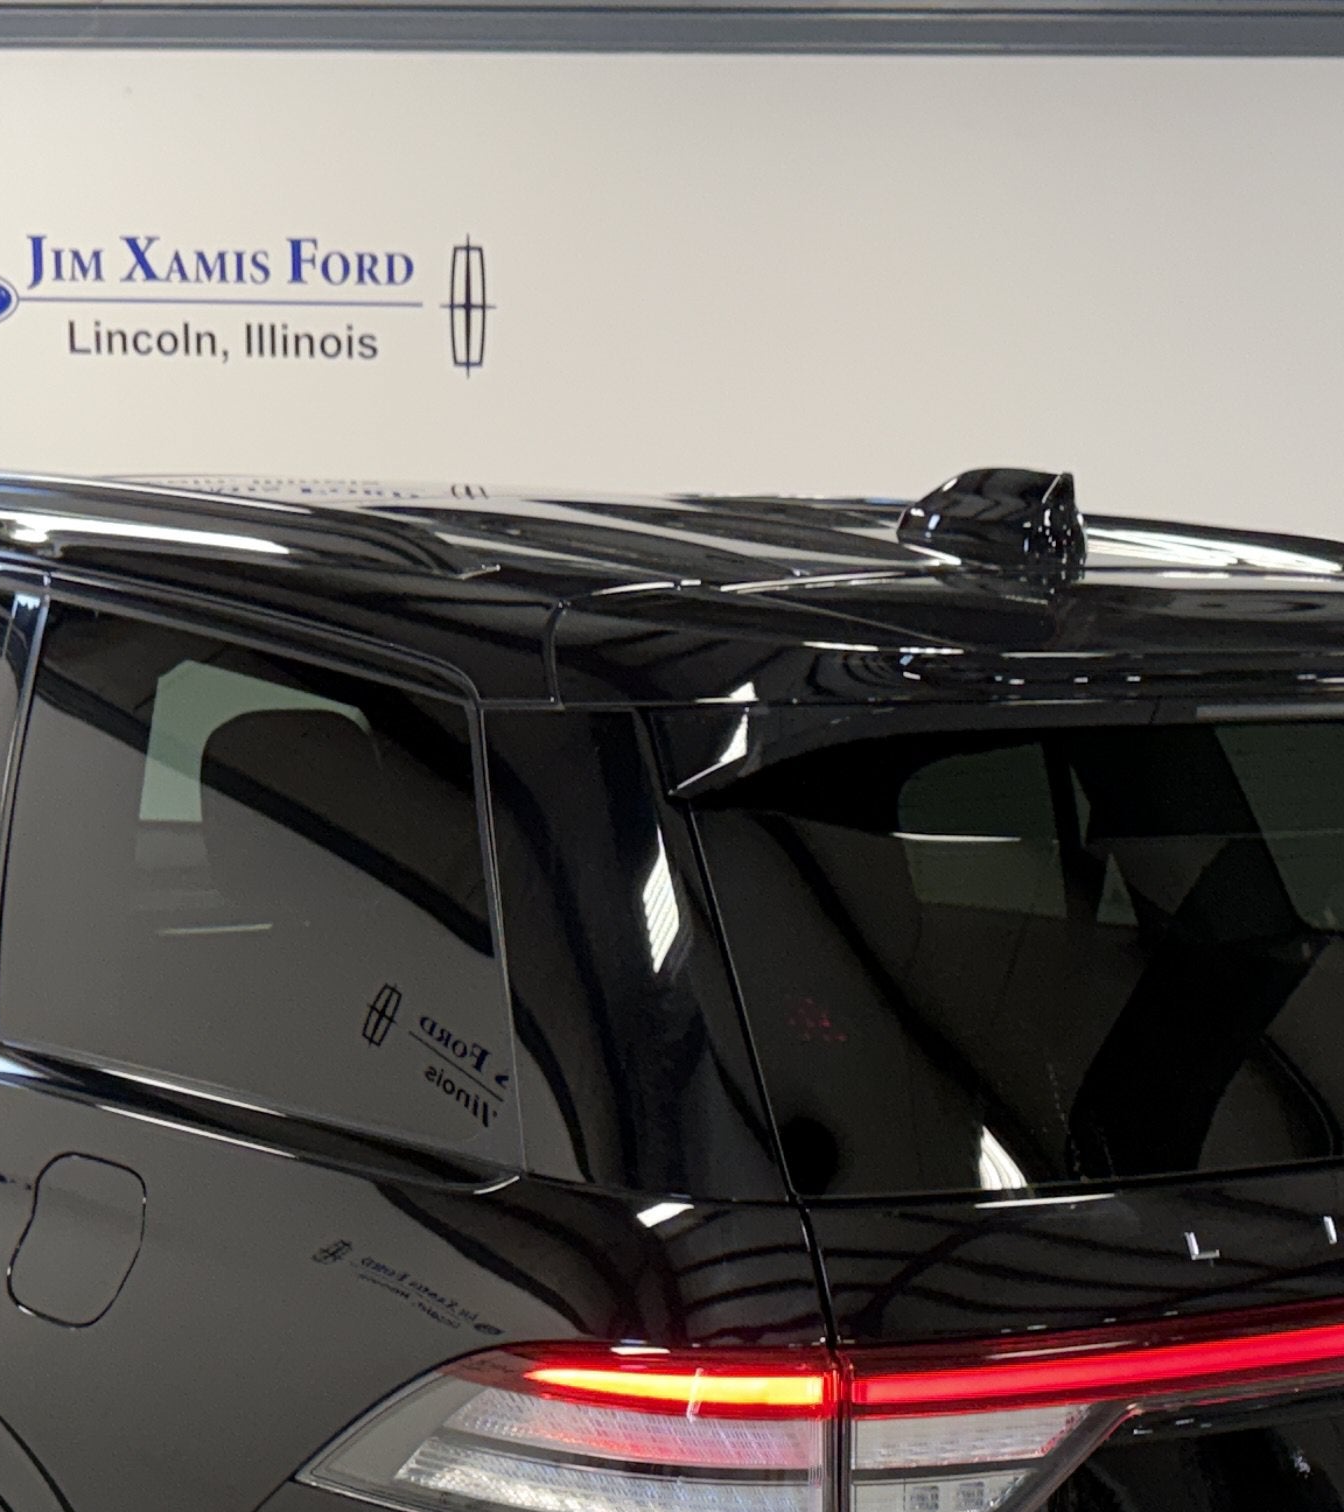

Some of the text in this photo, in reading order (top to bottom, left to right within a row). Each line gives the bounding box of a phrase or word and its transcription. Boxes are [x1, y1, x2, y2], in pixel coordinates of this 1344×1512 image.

[26, 234, 415, 290] JIM XAMIS FORD
[67, 319, 379, 364] Lincoln, Illinois
